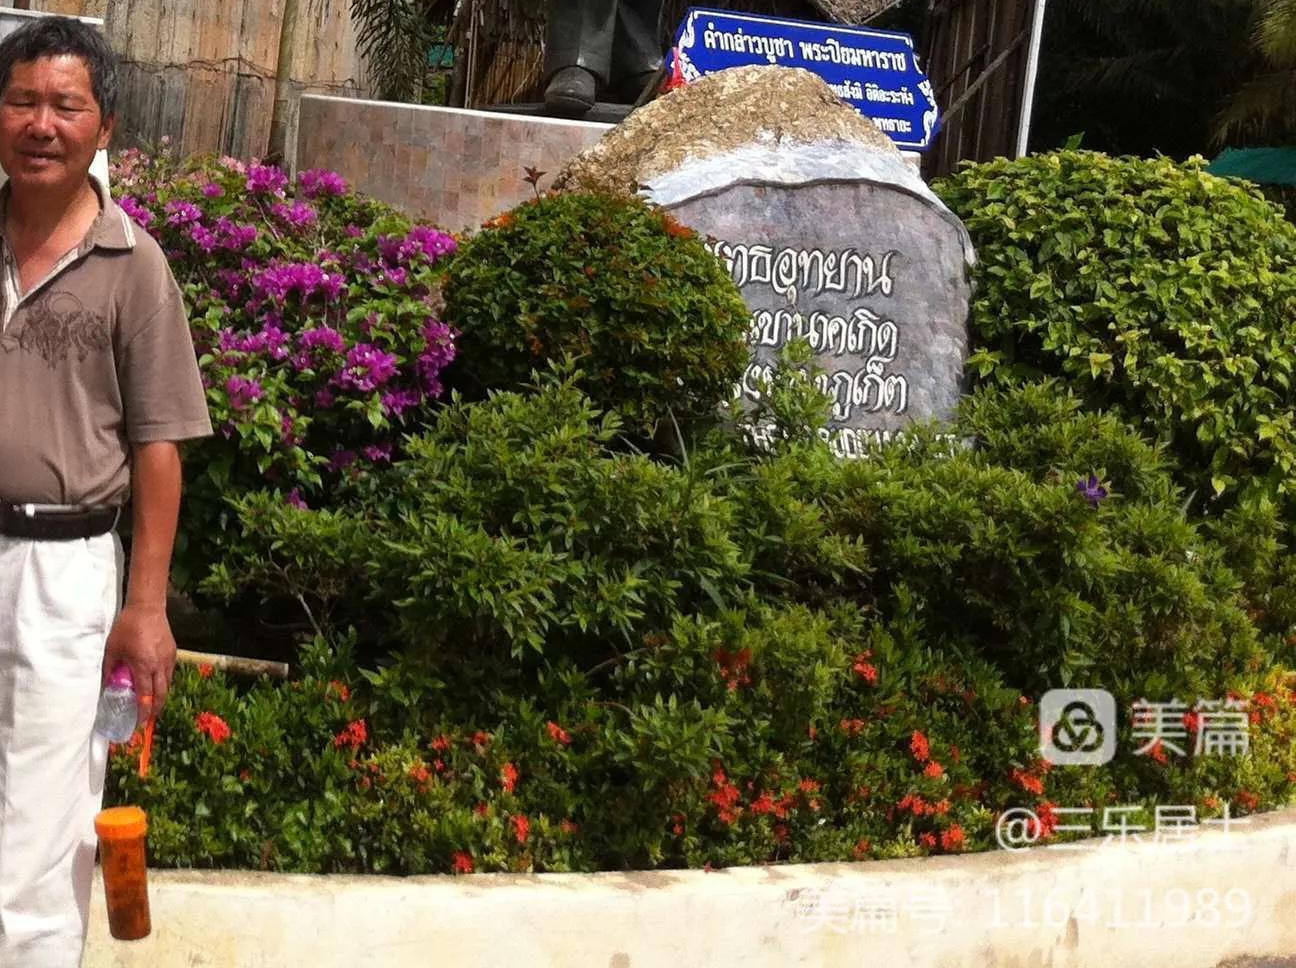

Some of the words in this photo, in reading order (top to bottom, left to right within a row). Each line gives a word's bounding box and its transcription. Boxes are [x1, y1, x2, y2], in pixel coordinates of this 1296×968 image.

[704, 22, 794, 63] คำกล่าวบูชา
[799, 38, 906, 71] พระปิยมหาราช
